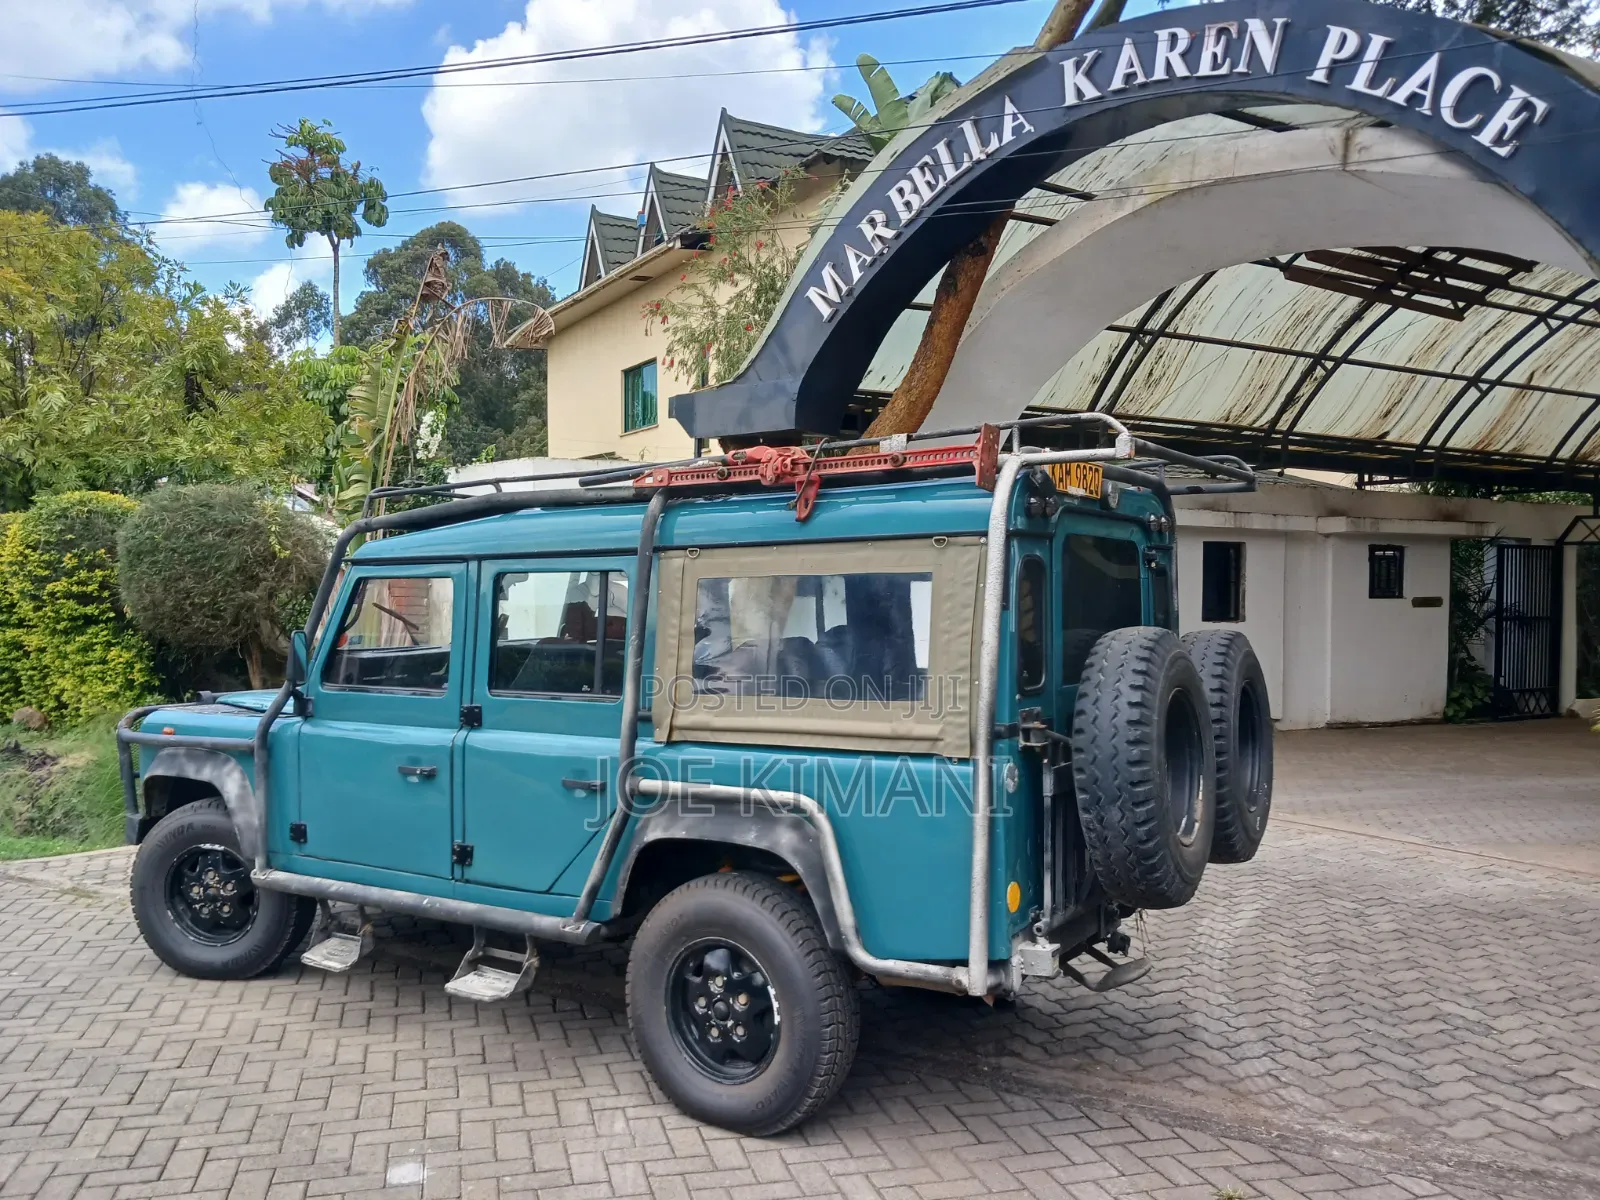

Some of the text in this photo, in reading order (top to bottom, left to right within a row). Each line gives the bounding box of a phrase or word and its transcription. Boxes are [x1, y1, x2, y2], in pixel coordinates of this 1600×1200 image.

[804, 18, 1549, 322] MARBELLA KAREN PLACE
